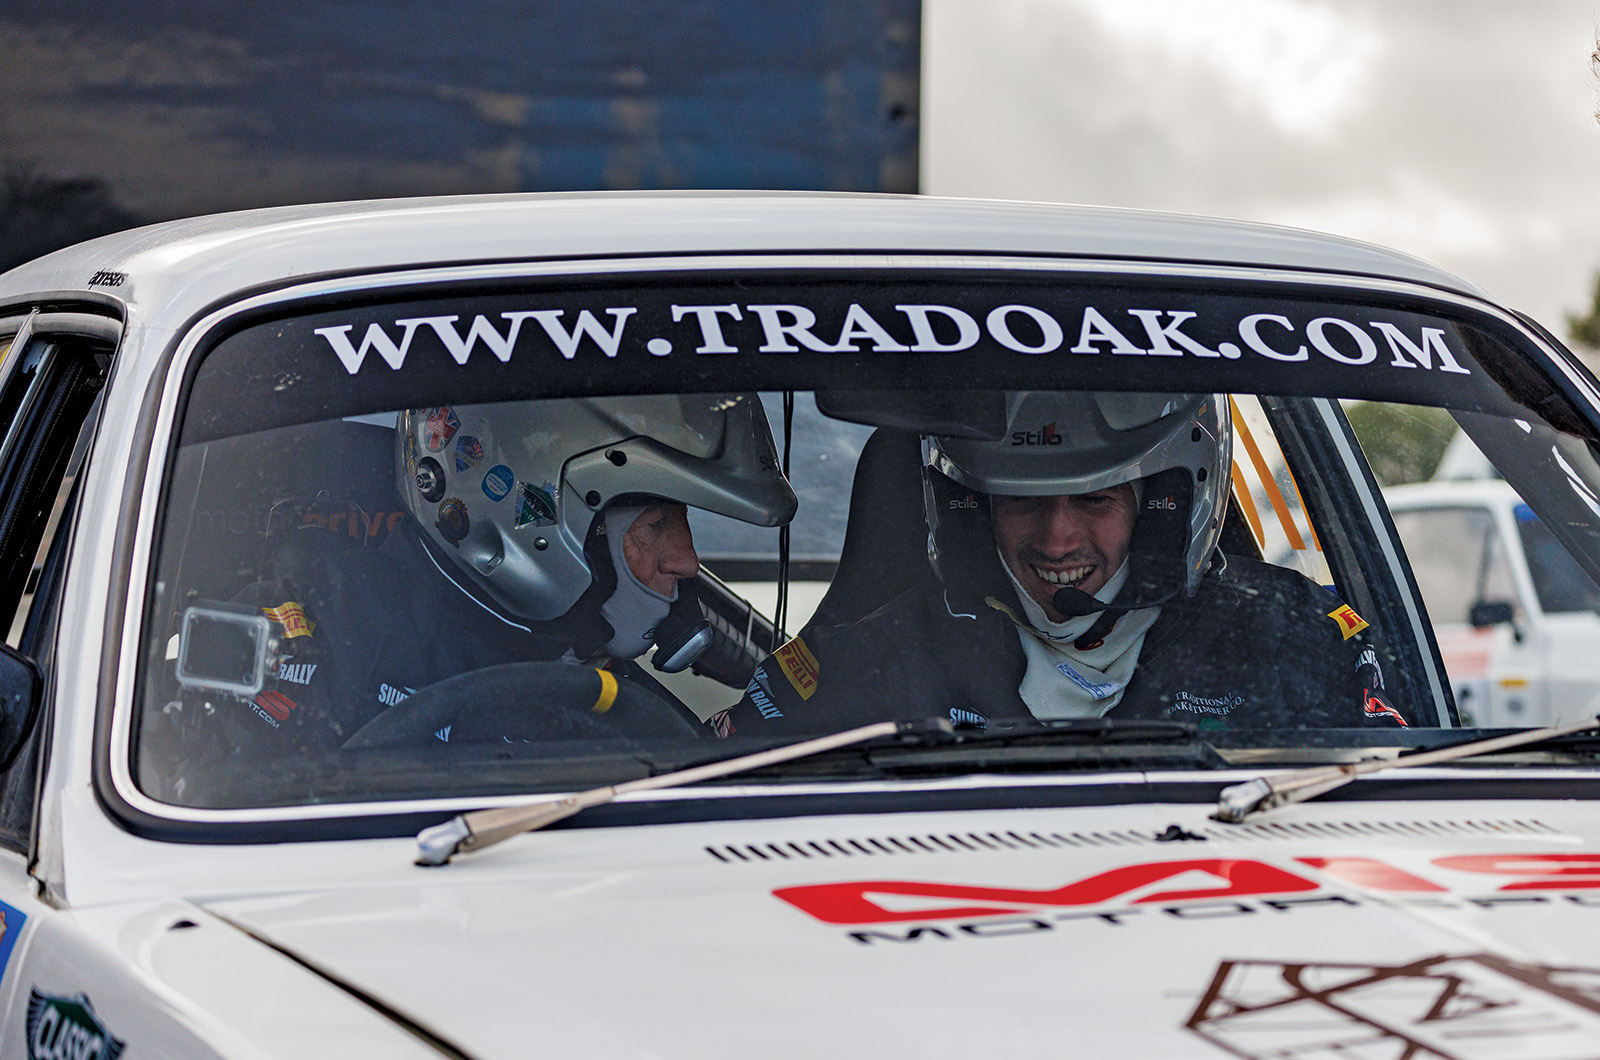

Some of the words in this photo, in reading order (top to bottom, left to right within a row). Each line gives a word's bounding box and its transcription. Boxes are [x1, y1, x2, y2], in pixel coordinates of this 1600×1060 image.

[313, 302, 1471, 376] WWW.TRADOAK.COM
[1011, 424, 1062, 446] Stilo
[949, 496, 978, 510] Stilo
[1147, 496, 1177, 511] Stilo
[279, 663, 318, 686] RALLY
[749, 690, 784, 720] RALLY
[1174, 691, 1234, 707] TRADITIONAL
